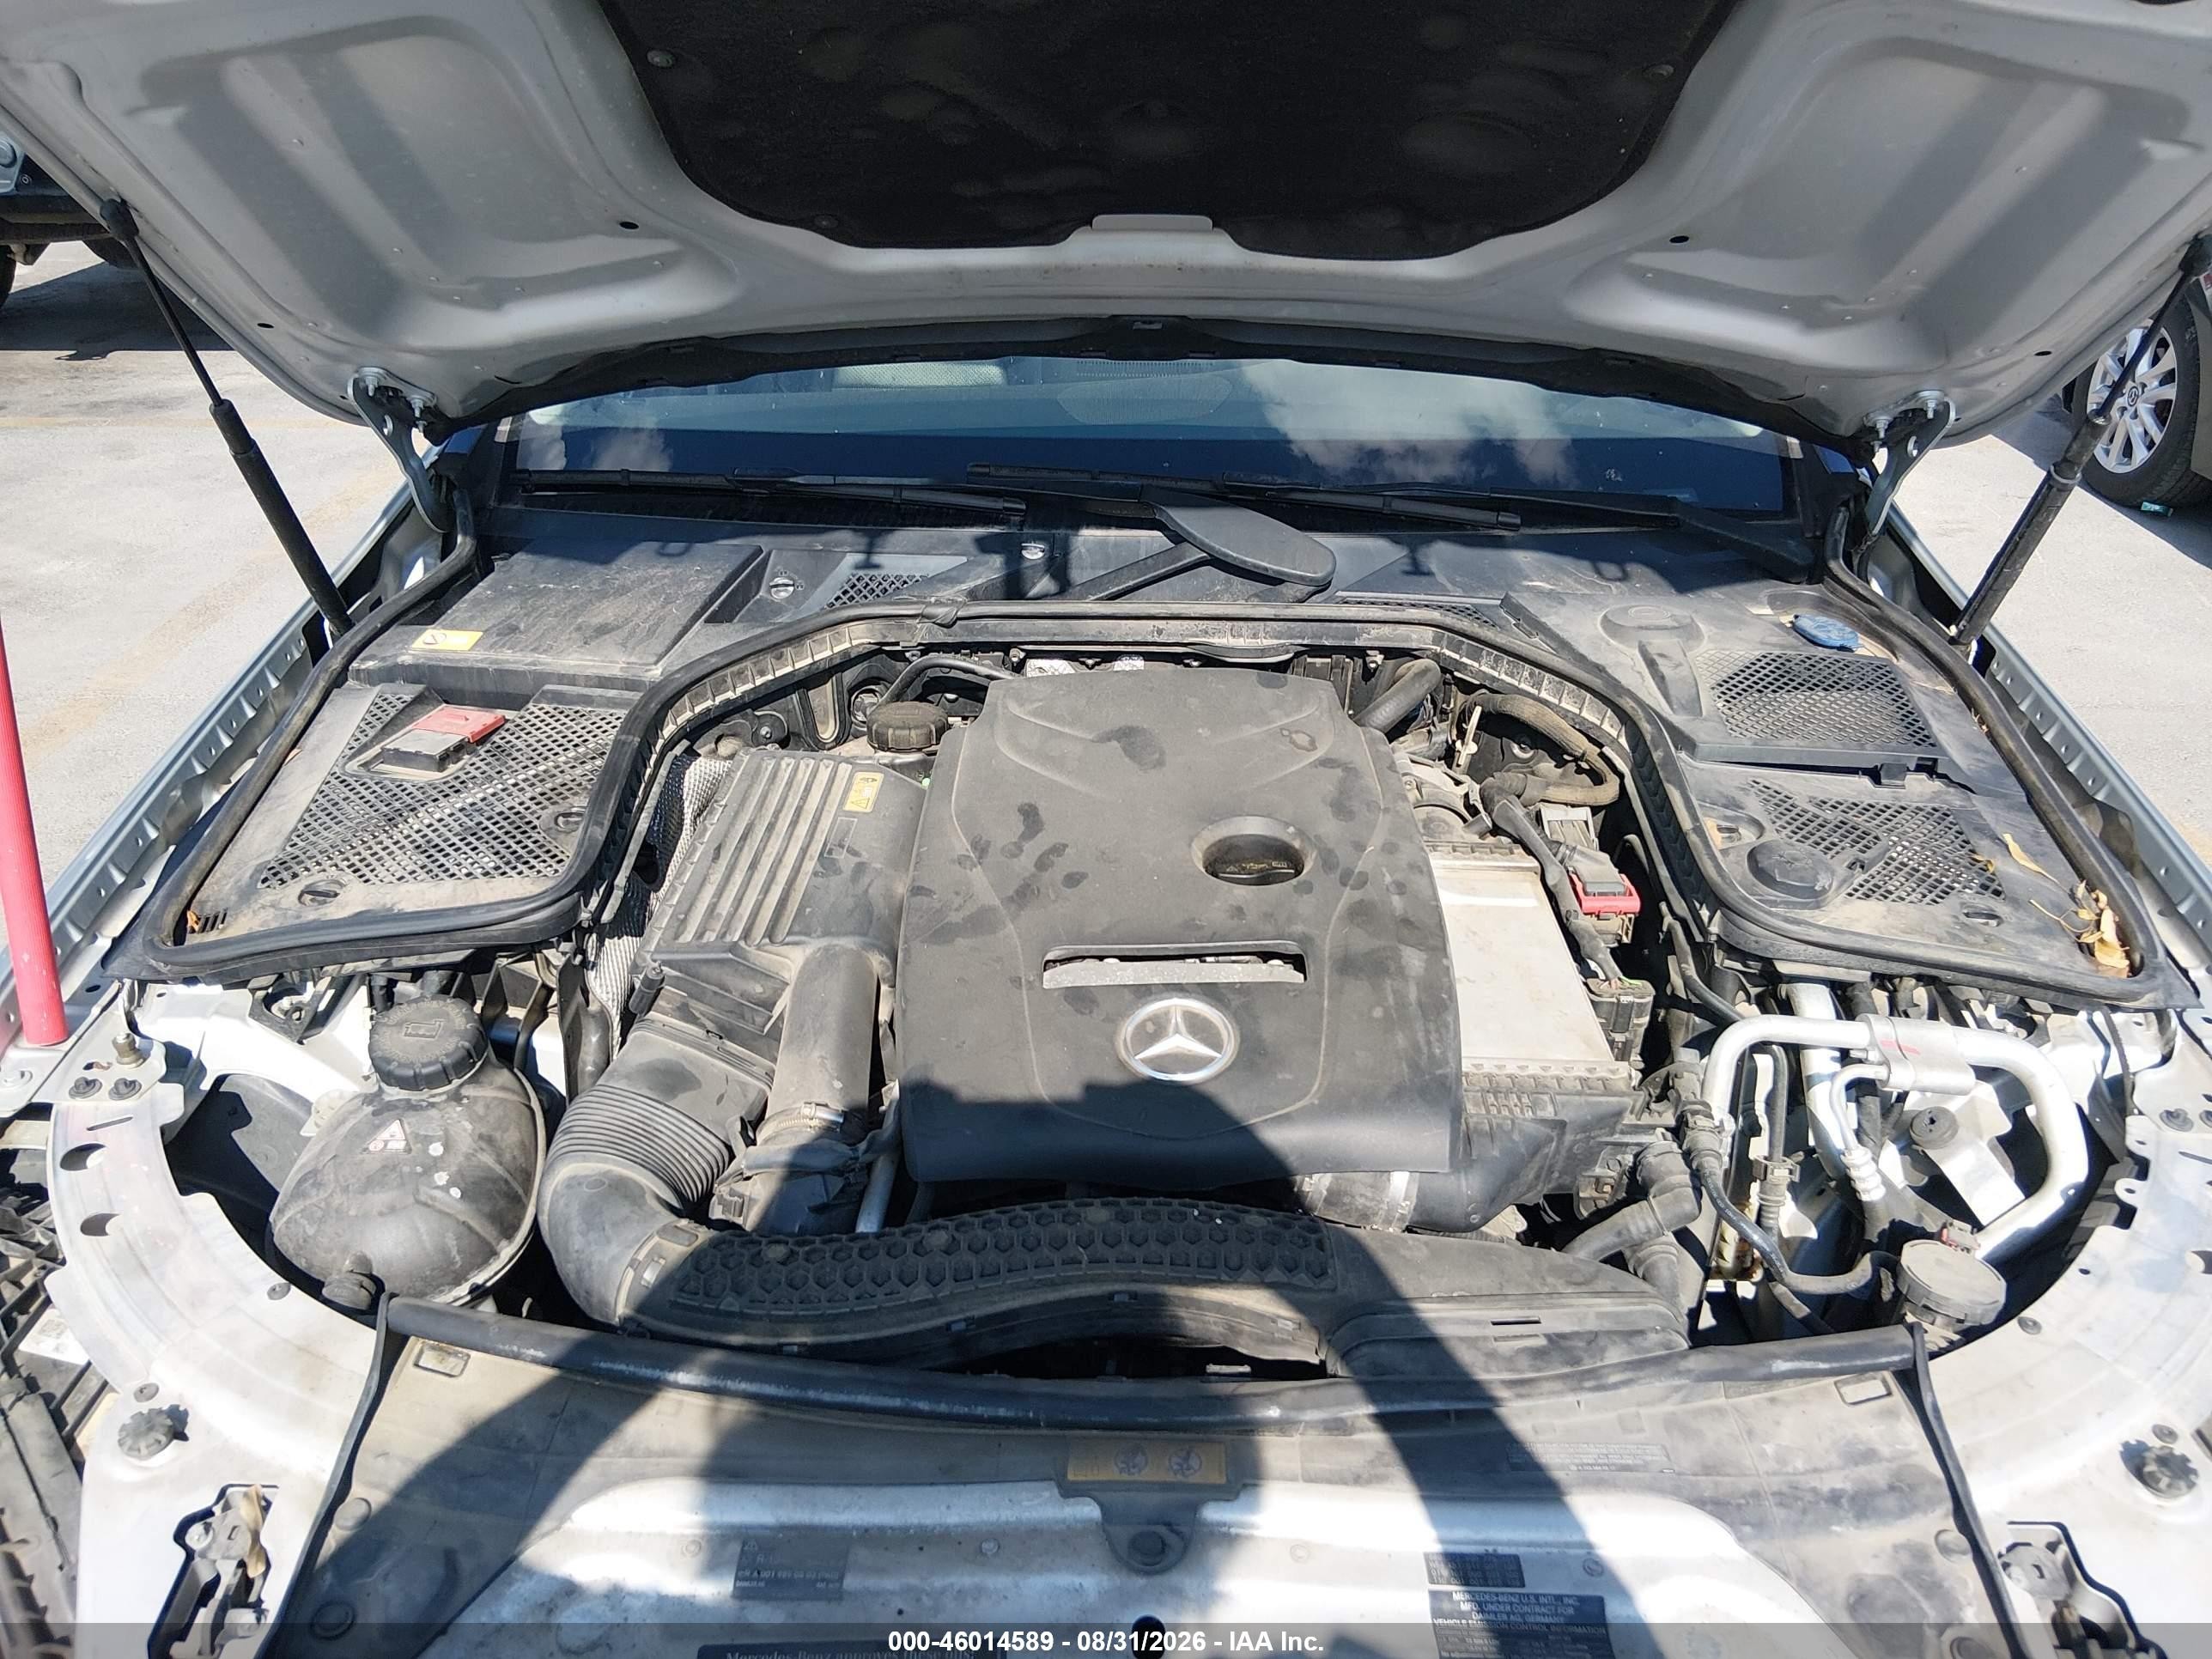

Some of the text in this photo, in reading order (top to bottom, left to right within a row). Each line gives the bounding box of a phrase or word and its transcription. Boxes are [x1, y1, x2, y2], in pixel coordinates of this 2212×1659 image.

[1482, 1602, 1511, 1613] UNDER
[1512, 1603, 1555, 1614] CONTRACT
[1557, 1606, 1575, 1615] FOR
[1432, 1618, 1607, 1634] VEHICLE EMISSION CONTROL INFORMATION
